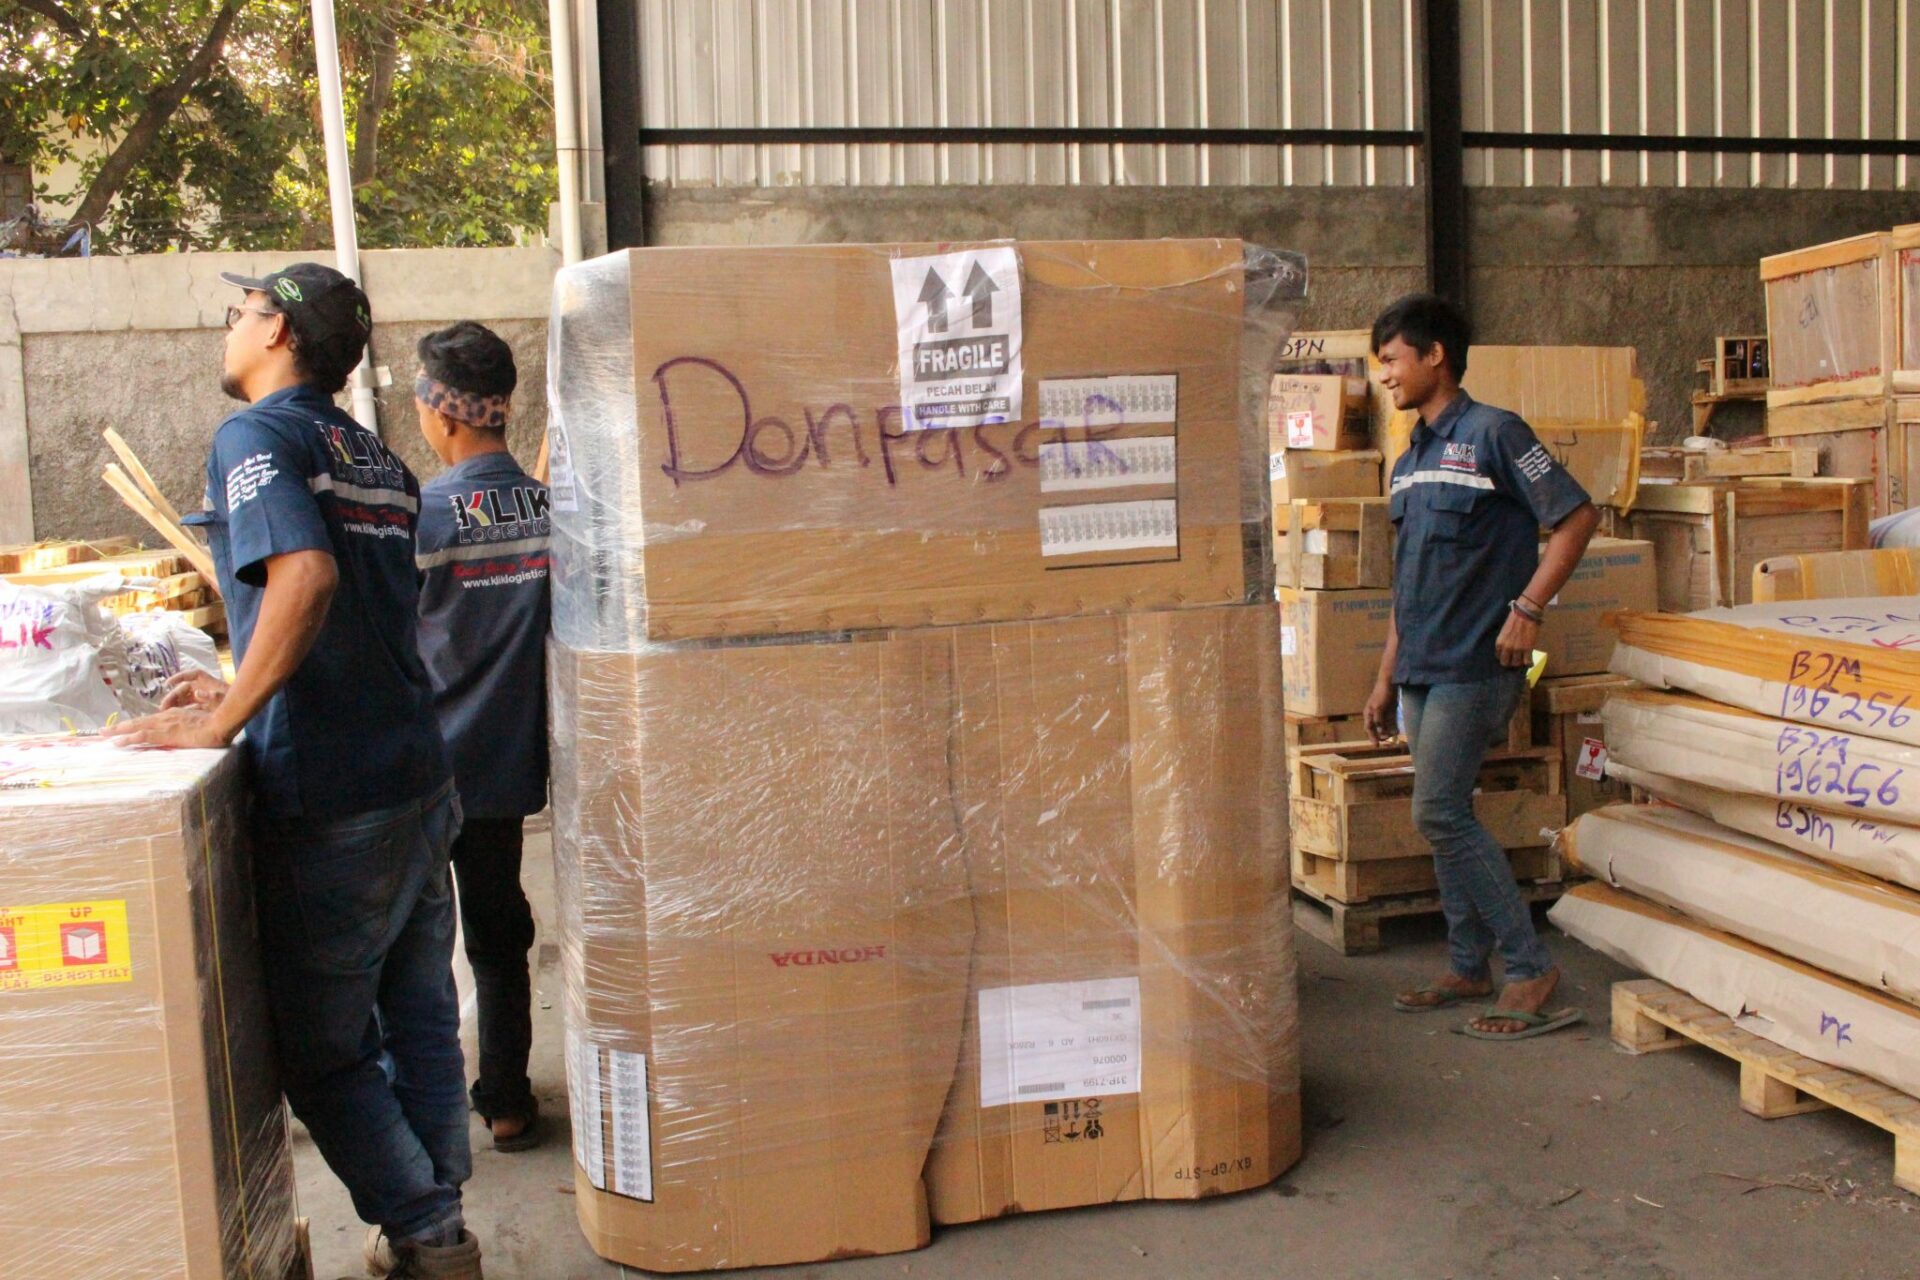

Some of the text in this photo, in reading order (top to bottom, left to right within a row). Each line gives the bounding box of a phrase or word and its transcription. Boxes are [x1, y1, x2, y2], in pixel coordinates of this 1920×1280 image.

[920, 343, 1004, 373] FRAGILE
[926, 382, 997, 397] PECAH BELAH
[920, 400, 1006, 416] HANDLE WITH CARE
[1443, 442, 1476, 457] KLIK
[448, 486, 551, 530] KLIK
[70, 906, 92, 919] UP
[768, 945, 887, 968] HONDA
[99, 967, 129, 979] TILT
[1174, 1157, 1252, 1180] GX/GP-STP
